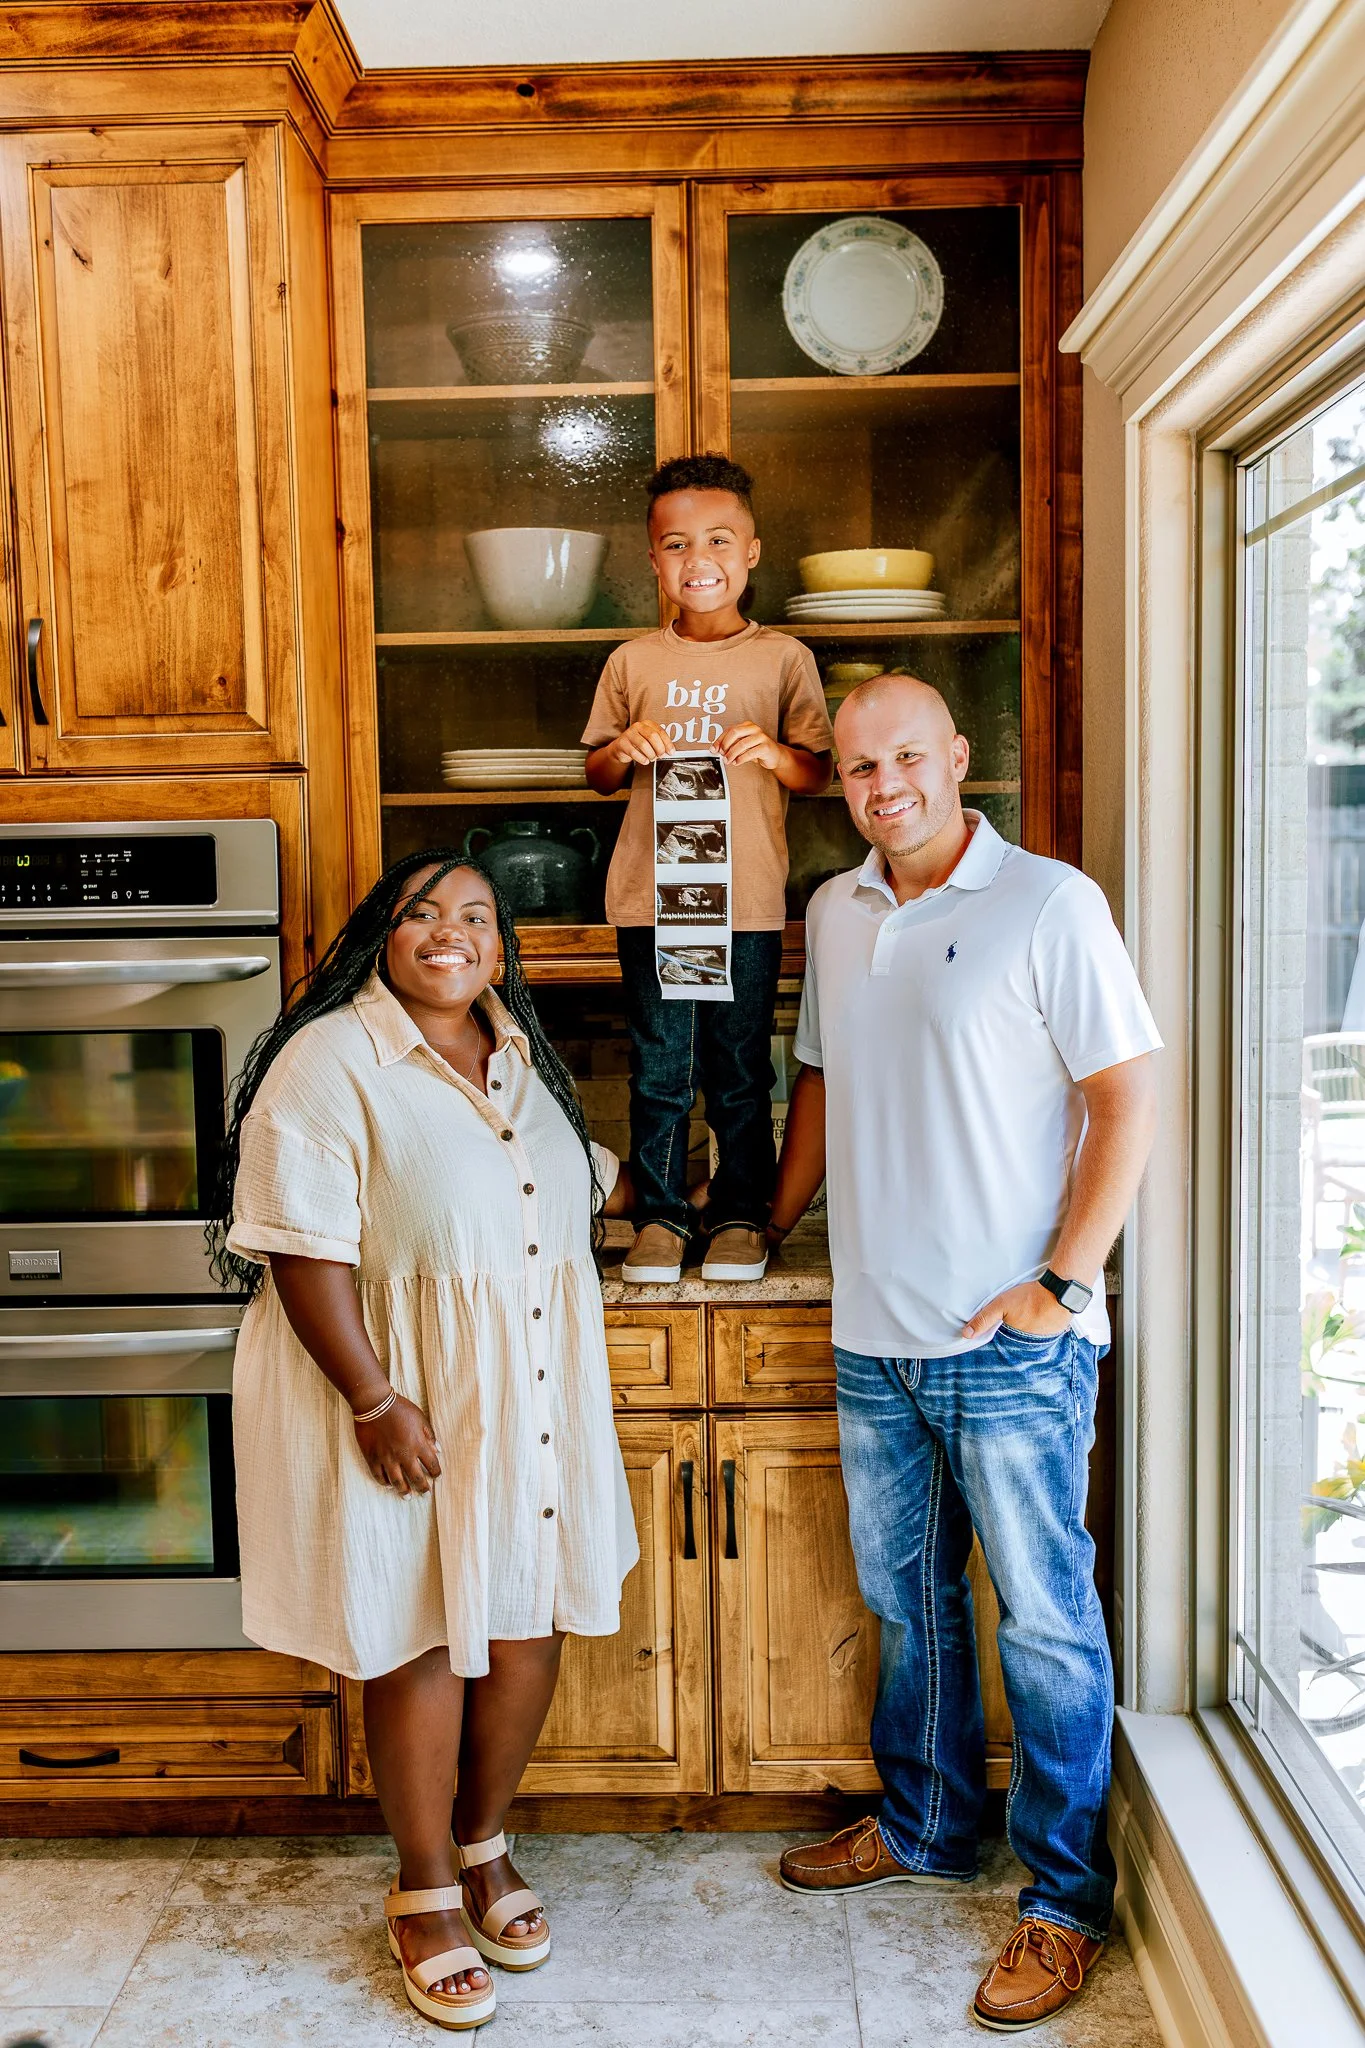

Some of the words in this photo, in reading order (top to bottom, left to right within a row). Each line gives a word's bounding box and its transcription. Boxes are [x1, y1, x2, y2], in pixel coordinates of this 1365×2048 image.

[664, 679, 729, 714] big
[660, 715, 723, 743] oth
[11, 1258, 58, 1266] FRIGIDAIRE
